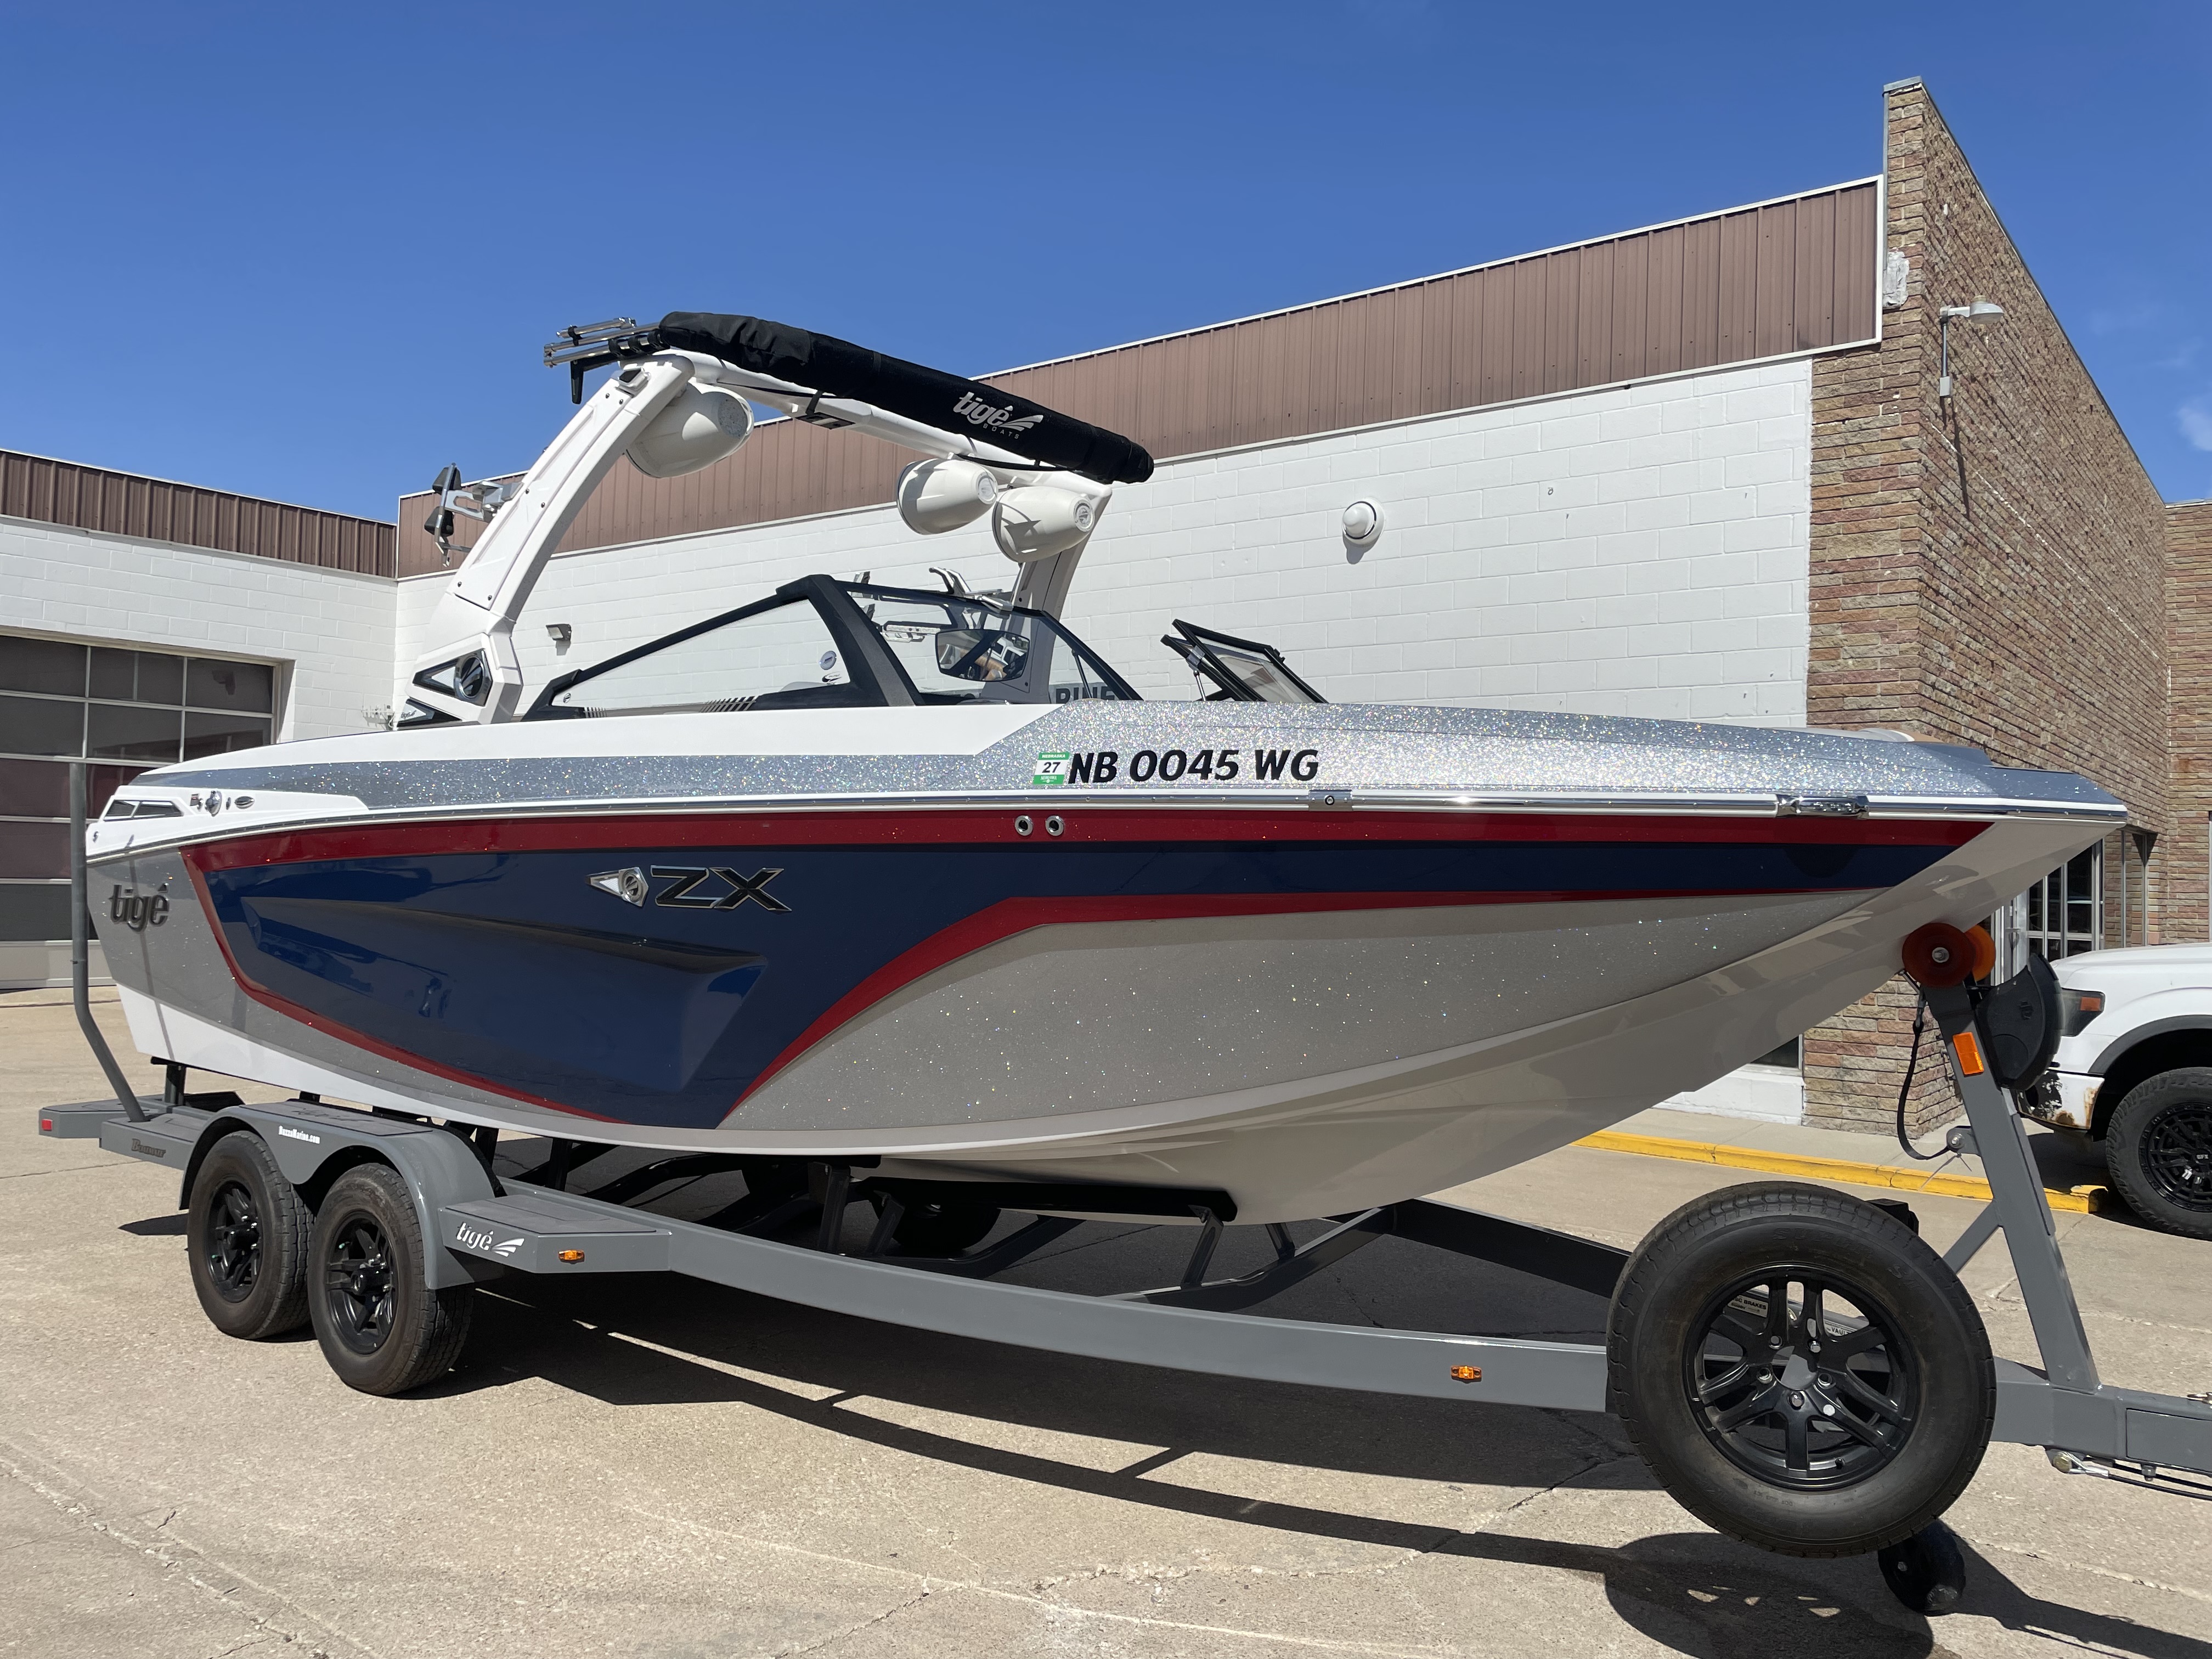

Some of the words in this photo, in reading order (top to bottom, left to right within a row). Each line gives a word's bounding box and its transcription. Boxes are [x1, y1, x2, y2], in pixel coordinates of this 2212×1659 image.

[952, 391, 1014, 426] tigé
[983, 423, 1019, 440] BOATS
[1042, 761, 1061, 774] 27
[1068, 751, 1118, 784] NB
[1130, 749, 1239, 782] 0045
[1255, 749, 1319, 781] WG
[650, 865, 792, 912] ZX
[108, 883, 170, 933] tigé
[456, 1221, 493, 1251] tigé
[1743, 1299, 1767, 1310] BRAKES
